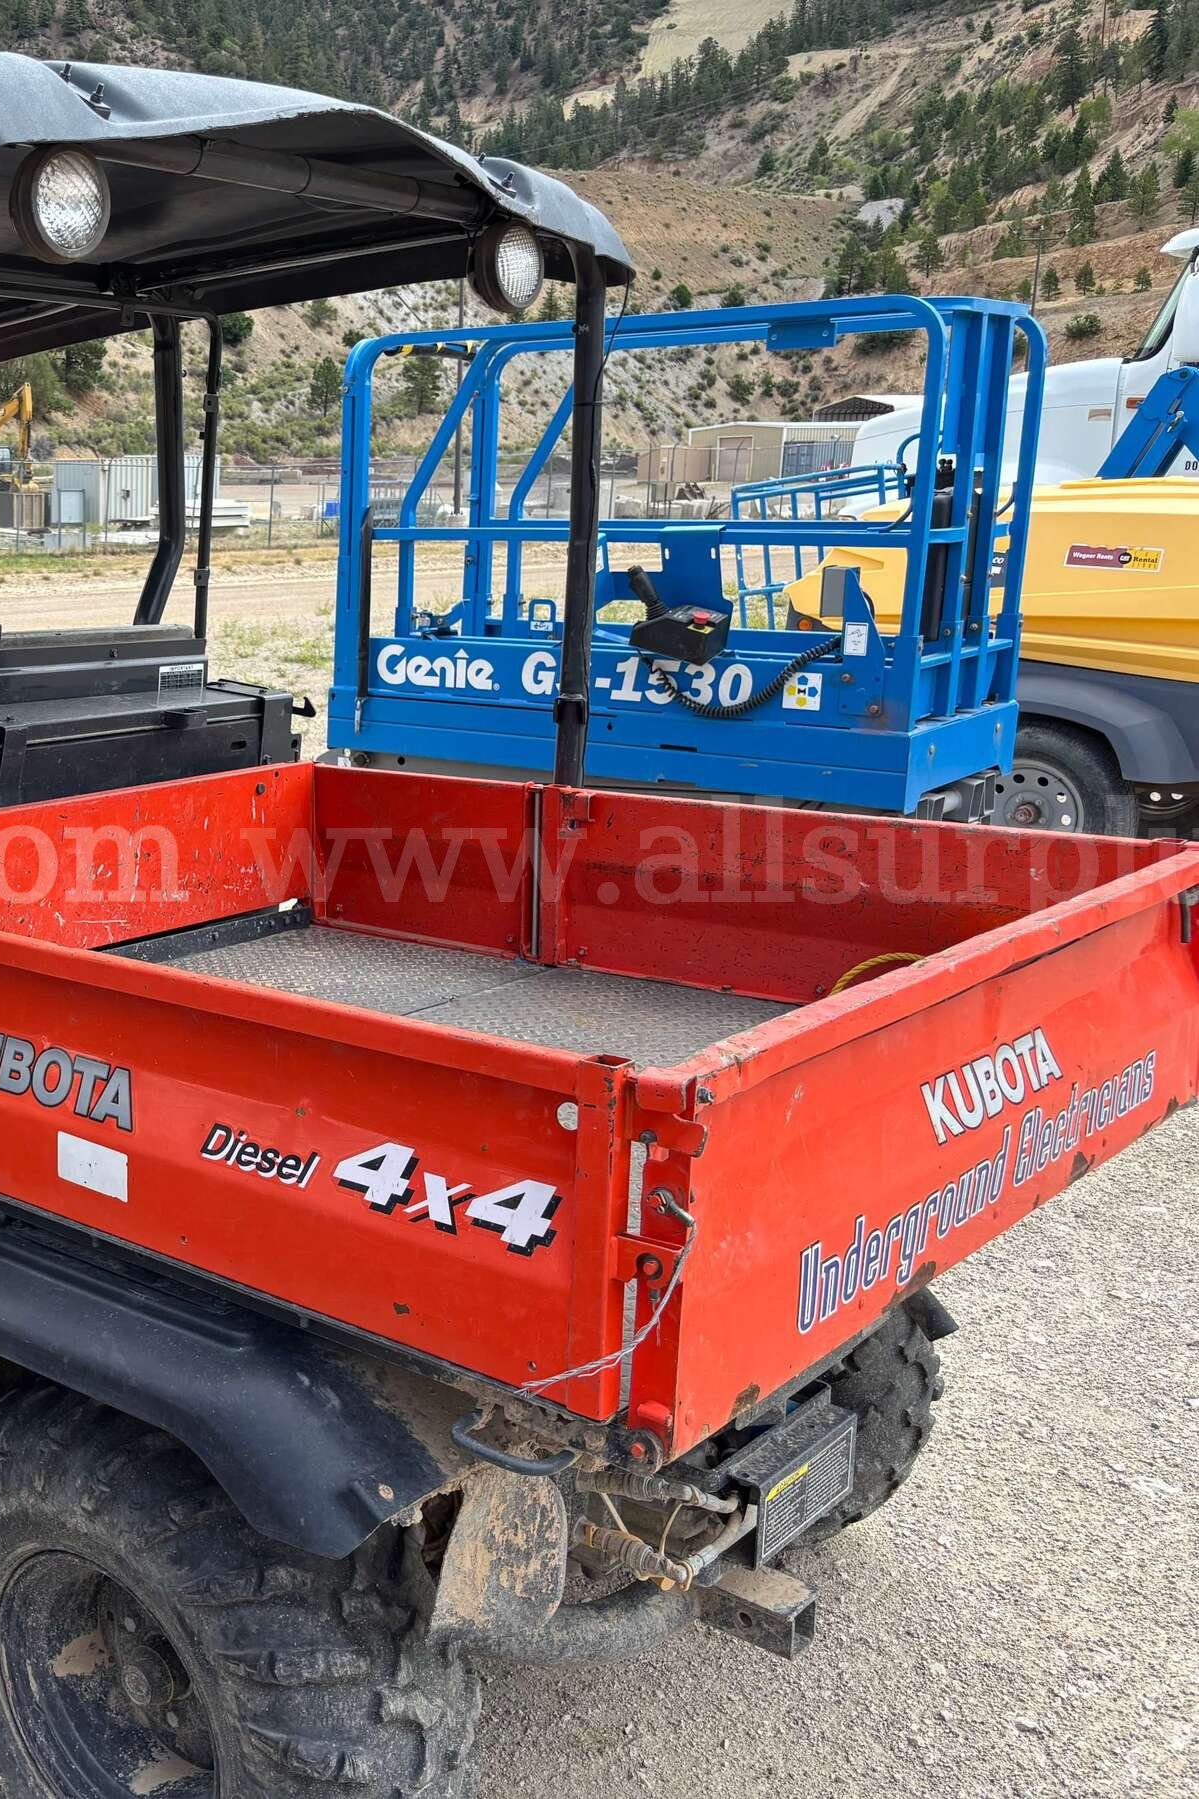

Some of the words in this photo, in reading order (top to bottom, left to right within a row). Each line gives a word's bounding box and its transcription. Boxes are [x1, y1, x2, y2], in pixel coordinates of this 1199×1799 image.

[1133, 556, 1158, 564] Rental
[377, 644, 494, 690] Genie
[521, 651, 753, 708] G-1530
[919, 1025, 1063, 1145] KUBOTA
[201, 1122, 321, 1189] Diesel
[797, 1125, 1010, 1334] Underground
[1013, 1050, 1156, 1189] Electricians
